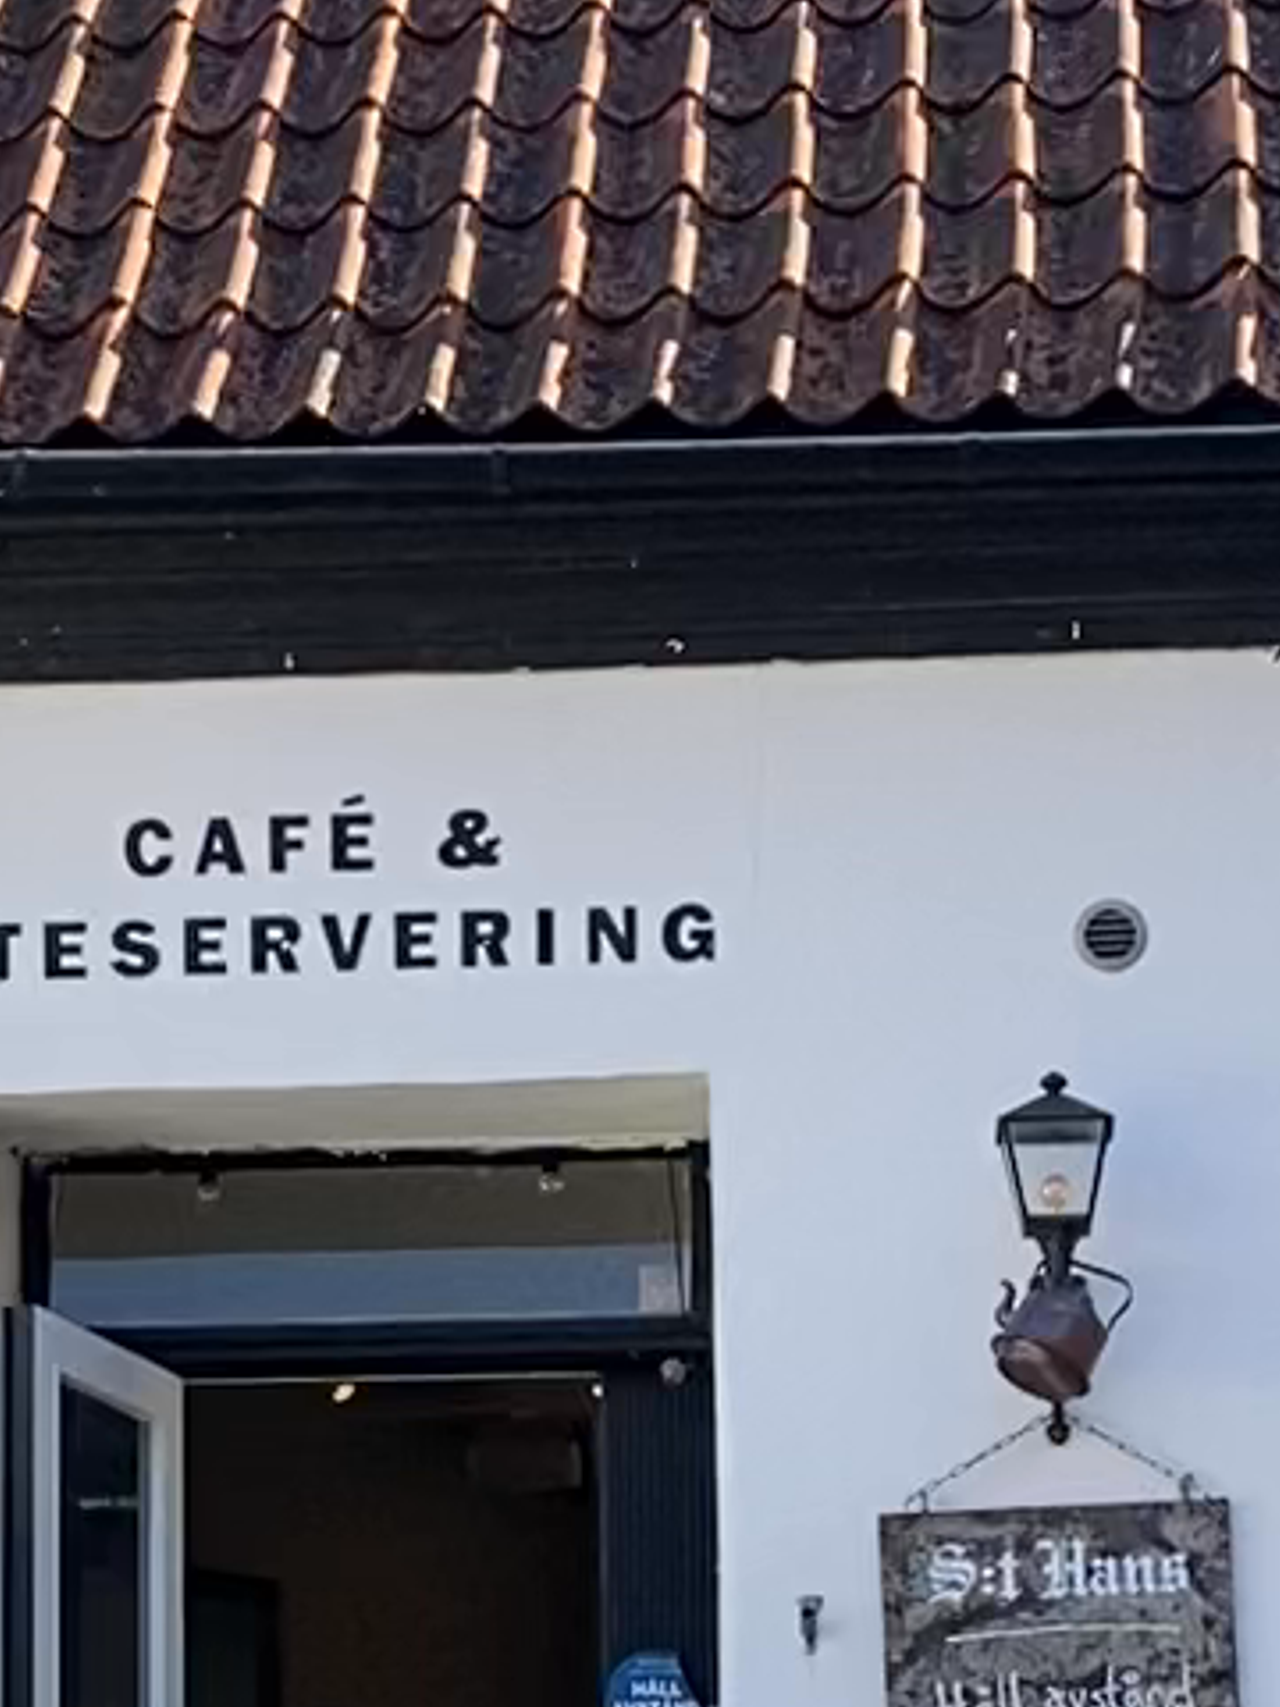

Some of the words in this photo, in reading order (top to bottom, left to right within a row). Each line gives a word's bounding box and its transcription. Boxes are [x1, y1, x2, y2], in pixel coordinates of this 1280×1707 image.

[123, 795, 376, 877] CAFÉ
[436, 808, 503, 870] &
[1037, 1538, 1193, 1600] Hans
